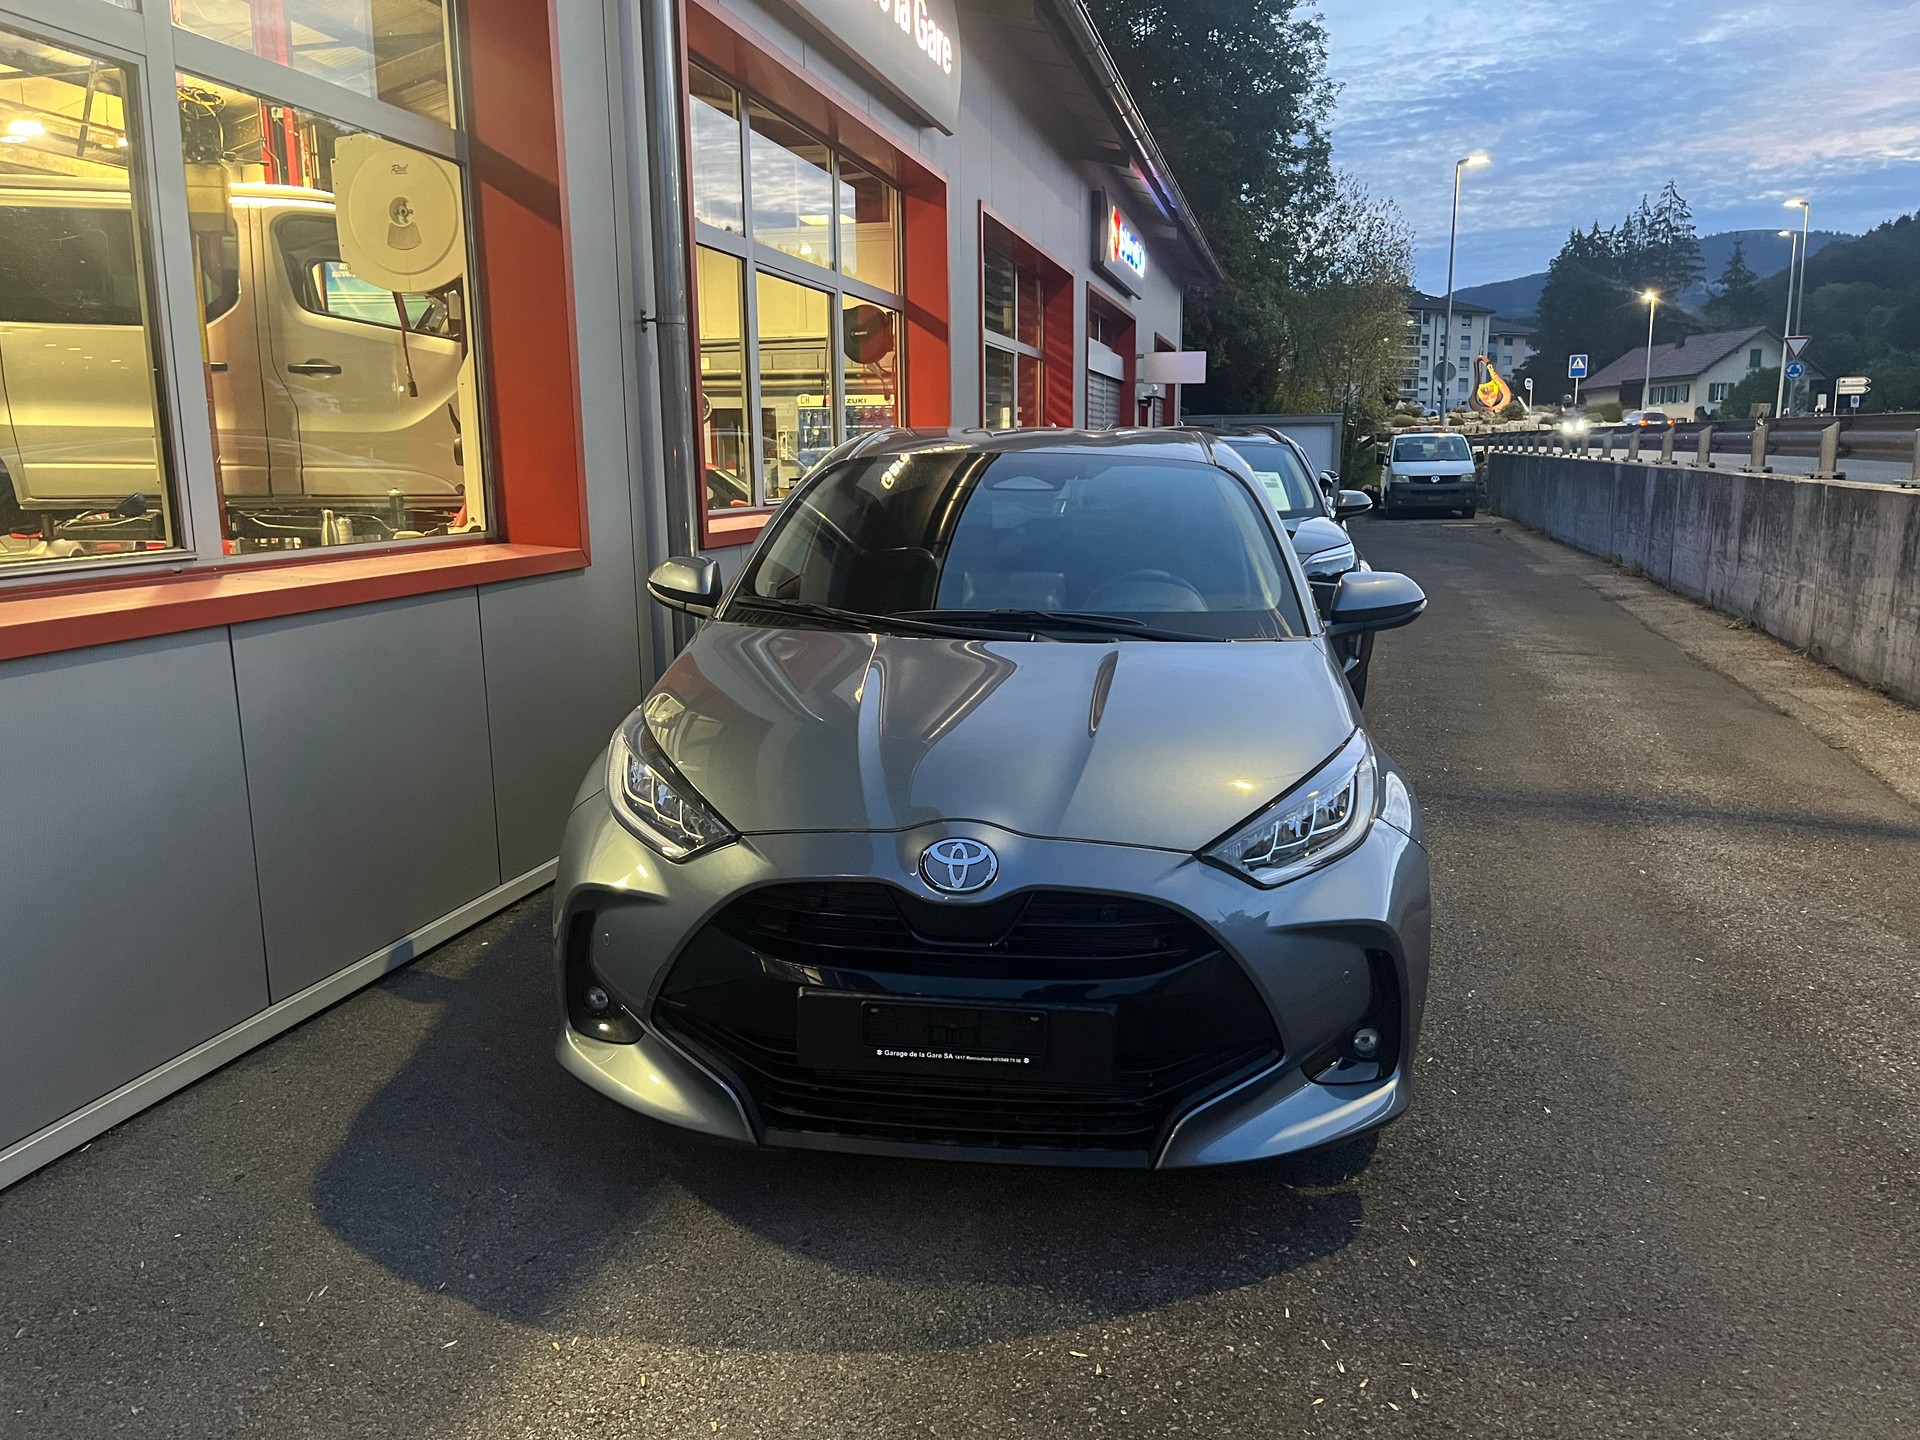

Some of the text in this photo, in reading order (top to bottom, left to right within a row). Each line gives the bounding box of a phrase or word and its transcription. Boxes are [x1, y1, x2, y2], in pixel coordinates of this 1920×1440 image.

[913, 0, 952, 75] Gare
[884, 1049, 908, 1058] Garage
[926, 1051, 943, 1059] Gare
[943, 1052, 954, 1060] SA
